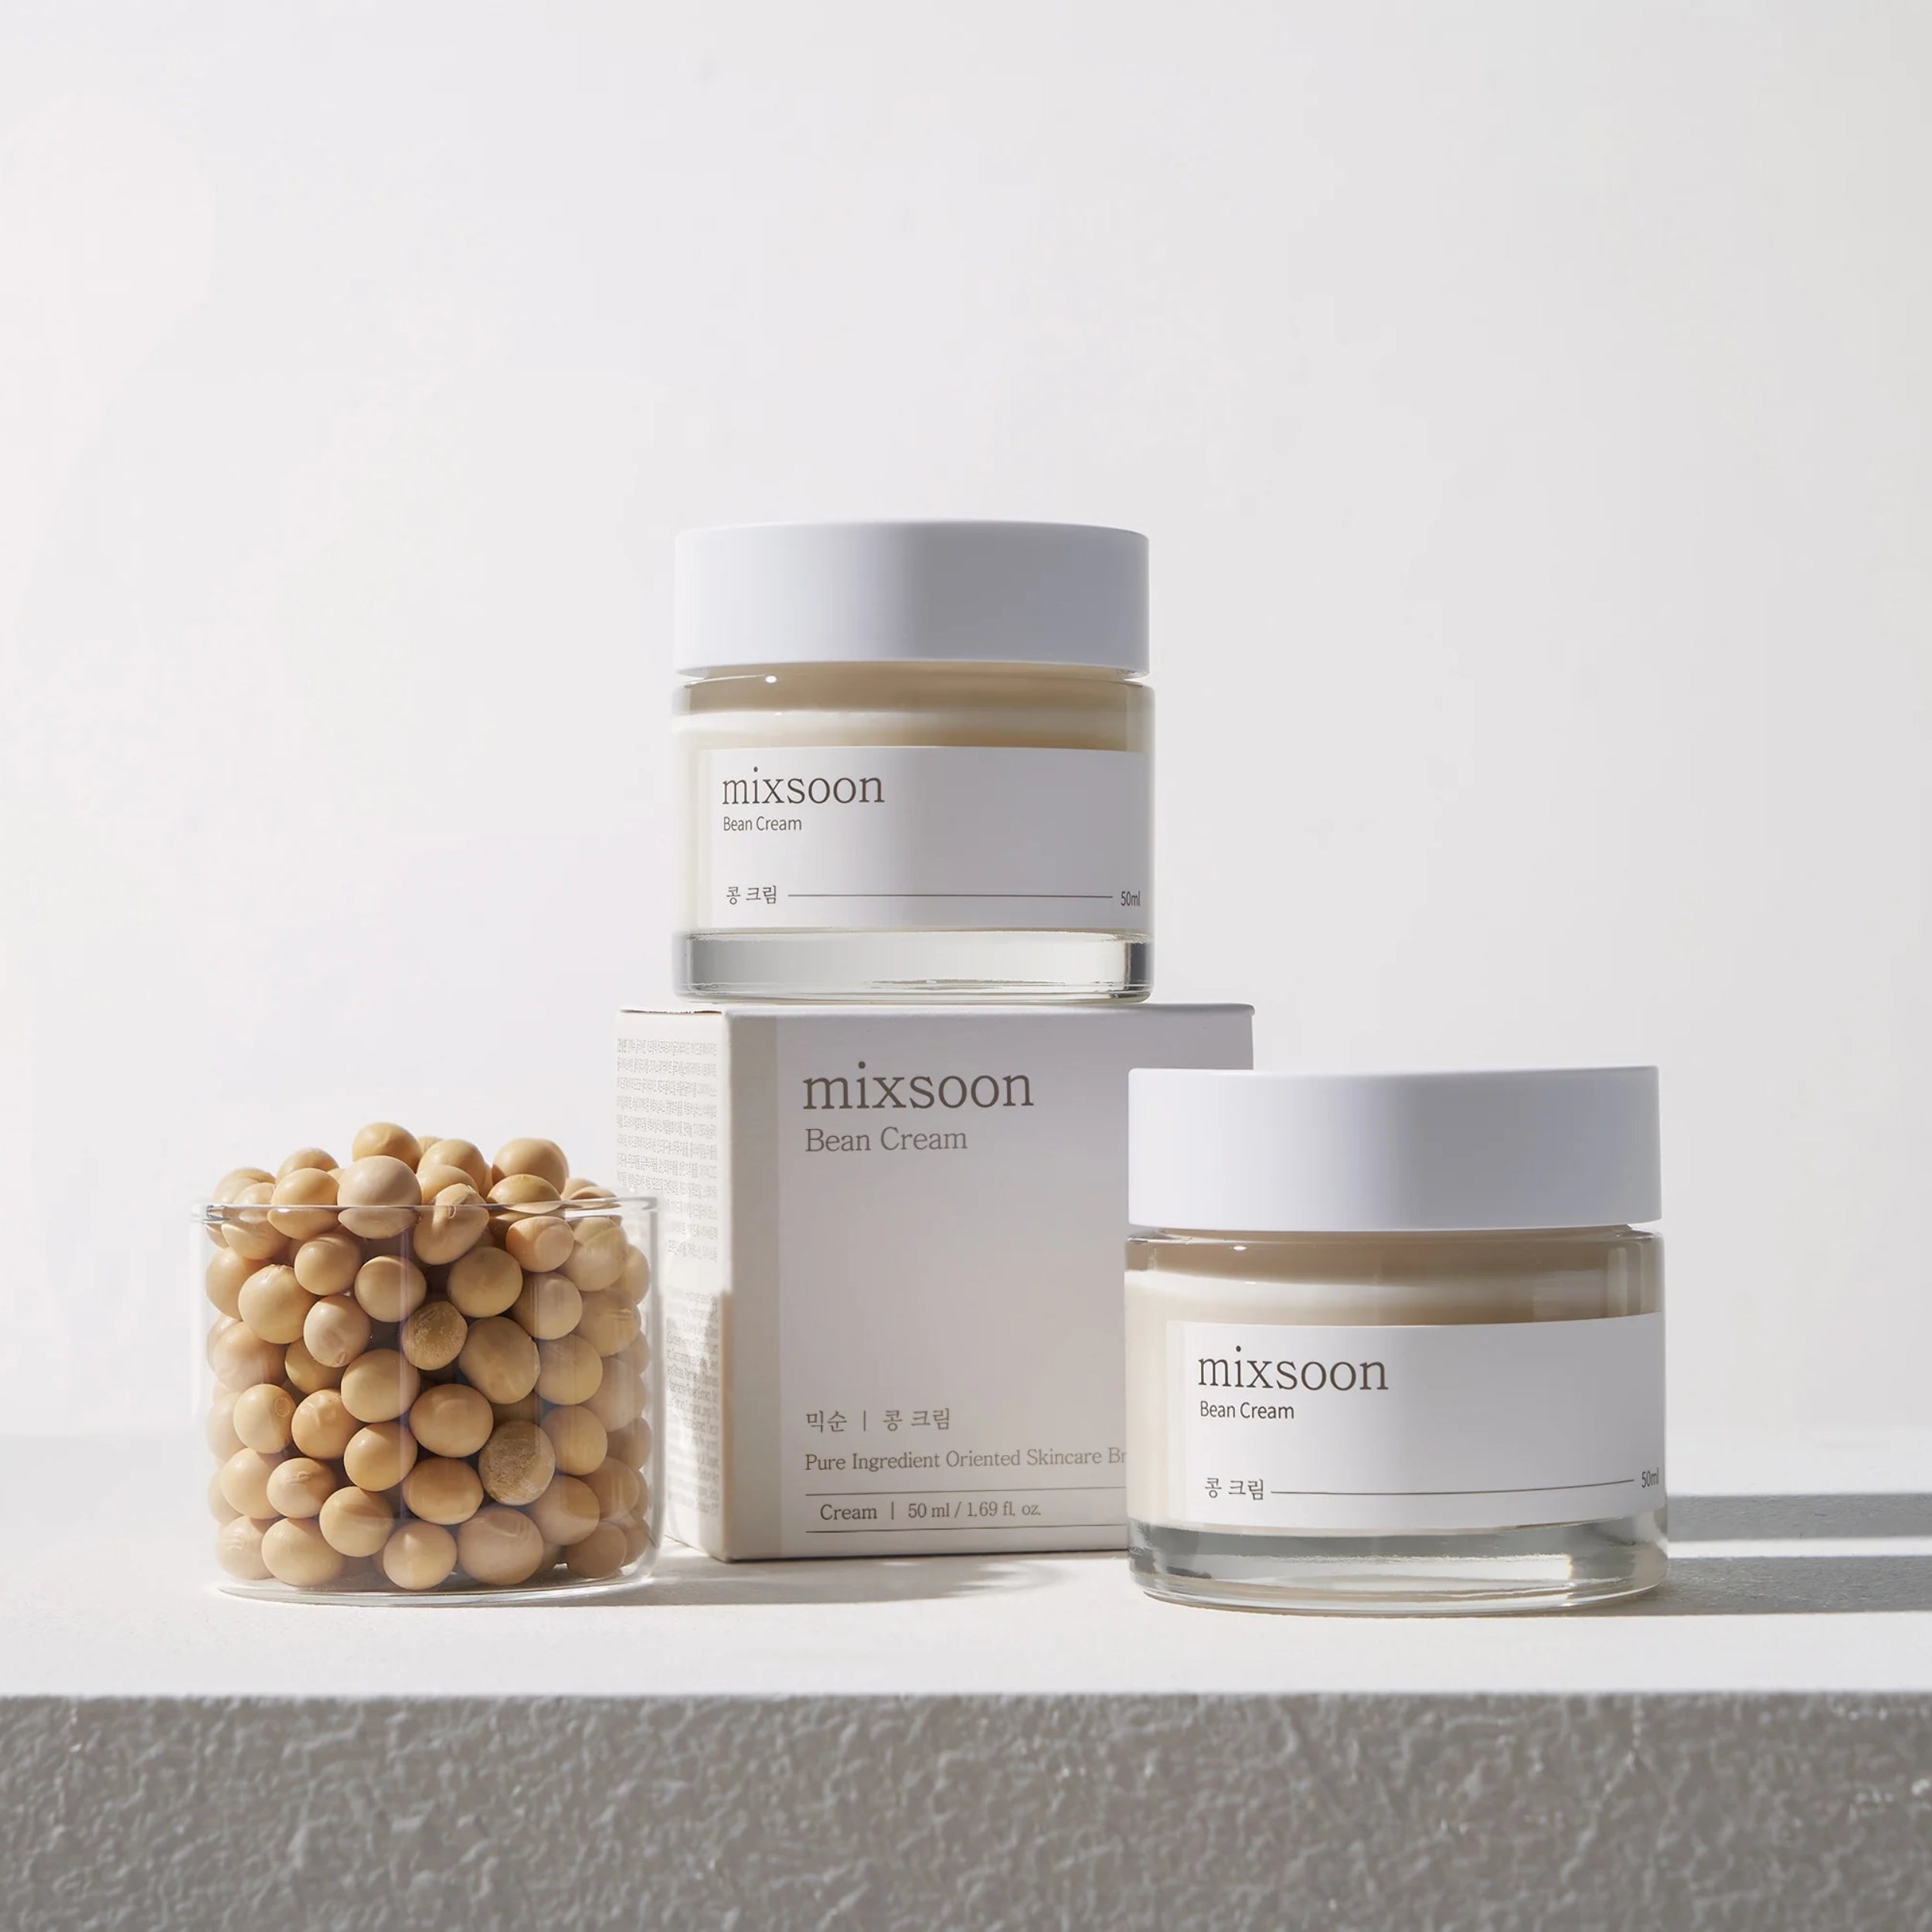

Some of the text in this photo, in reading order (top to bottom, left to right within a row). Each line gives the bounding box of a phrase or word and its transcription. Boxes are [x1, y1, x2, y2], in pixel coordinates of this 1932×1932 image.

[722, 766, 885, 805] mixsoon
[723, 815, 802, 832] Bean Cream
[726, 884, 1141, 906] 콩 크림 50ml
[802, 1060, 1035, 1110] mixsoon
[804, 1126, 968, 1152] Bean Cream
[1198, 1345, 1389, 1391] mixsoon
[805, 1410, 848, 1434] 믹순
[882, 1410, 903, 1432] 콩
[910, 1407, 950, 1430] 크림
[1200, 1400, 1294, 1420] Bean Cream
[804, 1454, 846, 1471] Pure
[852, 1451, 940, 1473] Ingredient
[945, 1449, 1021, 1468] Oriented
[1026, 1447, 1103, 1466] Skincare
[1204, 1467, 1659, 1501] 콩 크림 50ml
[820, 1503, 878, 1521] Cream
[907, 1502, 927, 1519] 50
[930, 1502, 951, 1518] ml
[967, 1501, 998, 1518] 1.69
[1002, 1500, 1016, 1517] fl.
[1022, 1504, 1042, 1516] oz.
